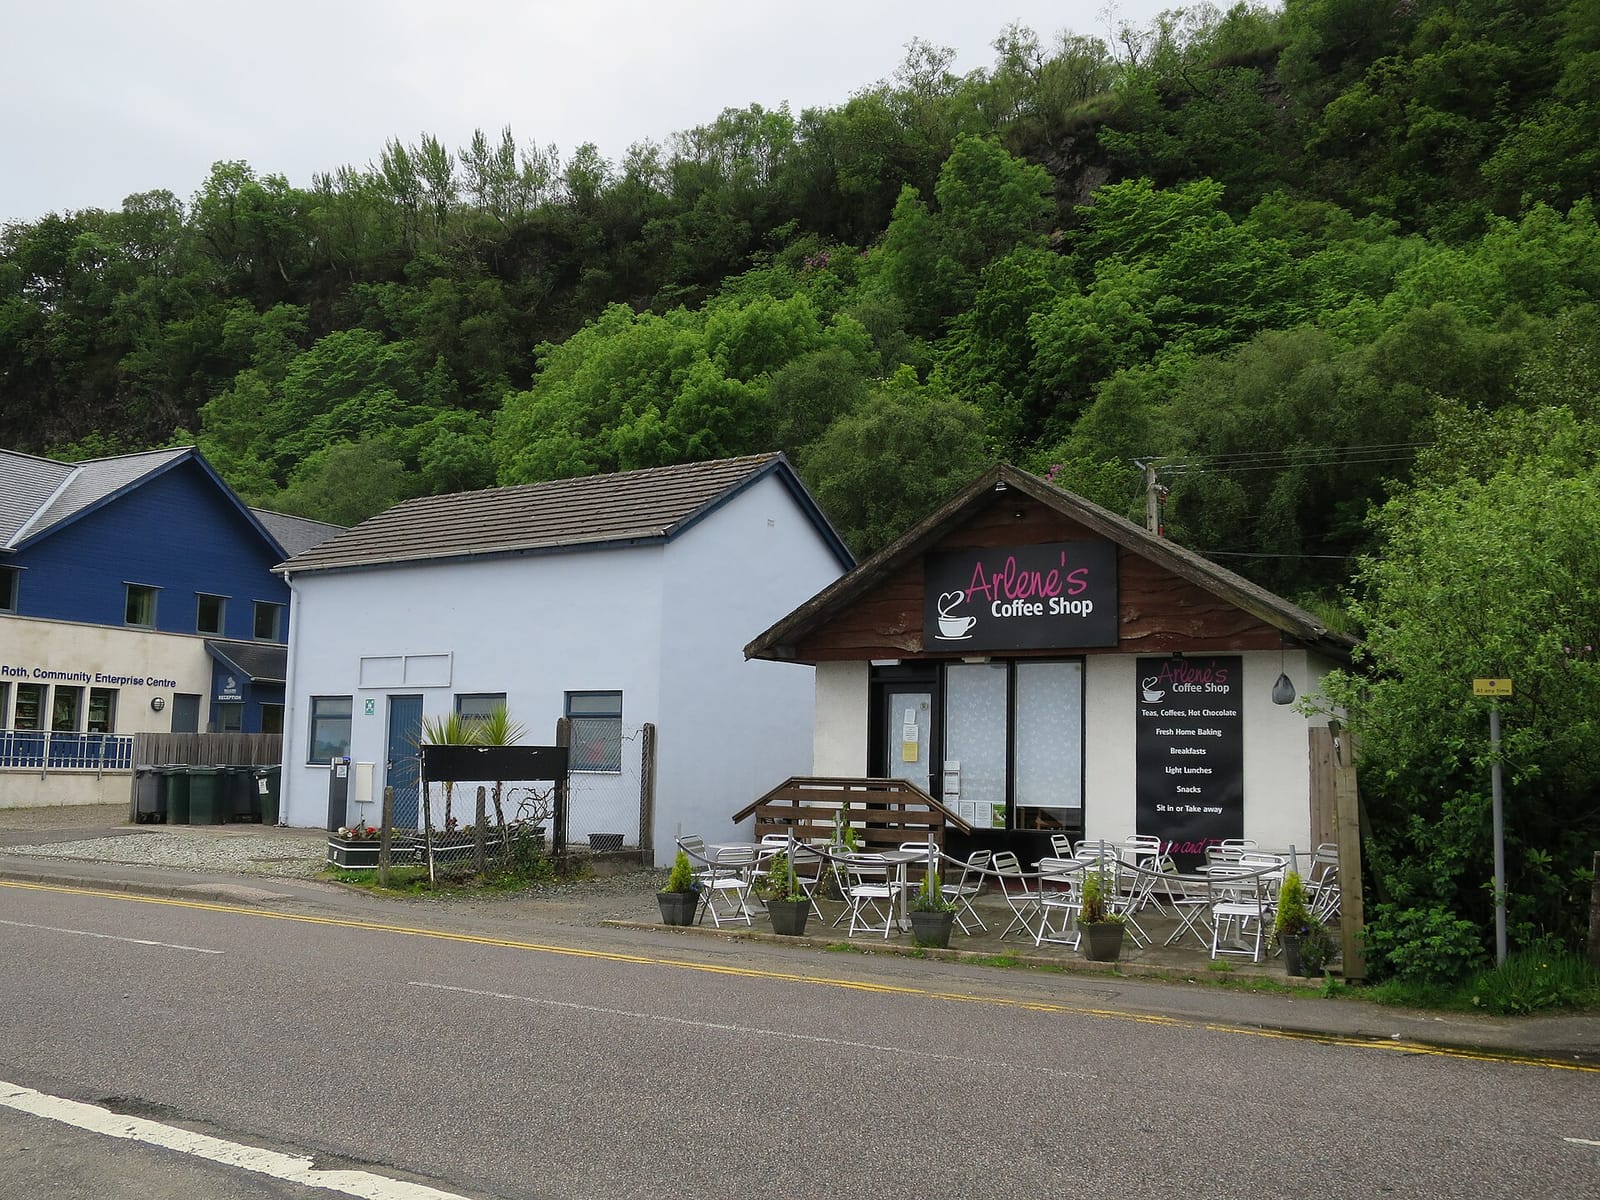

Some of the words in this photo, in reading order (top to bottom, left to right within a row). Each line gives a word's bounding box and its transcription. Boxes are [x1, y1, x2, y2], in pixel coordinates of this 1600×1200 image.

[964, 551, 1089, 603] Arlene's
[991, 599, 1043, 618] Coffee
[1049, 596, 1093, 618] Shop
[1, 665, 30, 679] Roth,
[33, 667, 92, 684] Community
[95, 672, 144, 687] Enterprise
[146, 676, 177, 688] Centre
[1158, 660, 1229, 684] Arlene's
[1172, 682, 1202, 693] Coffee
[1205, 682, 1230, 694] Shop
[1141, 709, 1159, 718] Teas,
[1160, 709, 1187, 718] Coffees,
[1188, 709, 1201, 717] Hot
[1202, 709, 1237, 717] Chocolate
[1155, 728, 1174, 736] Fresh
[1175, 728, 1196, 736] Home
[1197, 728, 1222, 737] Baking
[1170, 747, 1207, 755] Breakfasts
[1165, 766, 1182, 775] Light
[1183, 766, 1213, 774] Lunches
[1176, 785, 1202, 793] Snacks
[1156, 804, 1166, 812] Sit
[1167, 804, 1174, 812] in
[1185, 804, 1202, 813] Take
[1202, 806, 1223, 815] away
[1180, 838, 1207, 854] and
